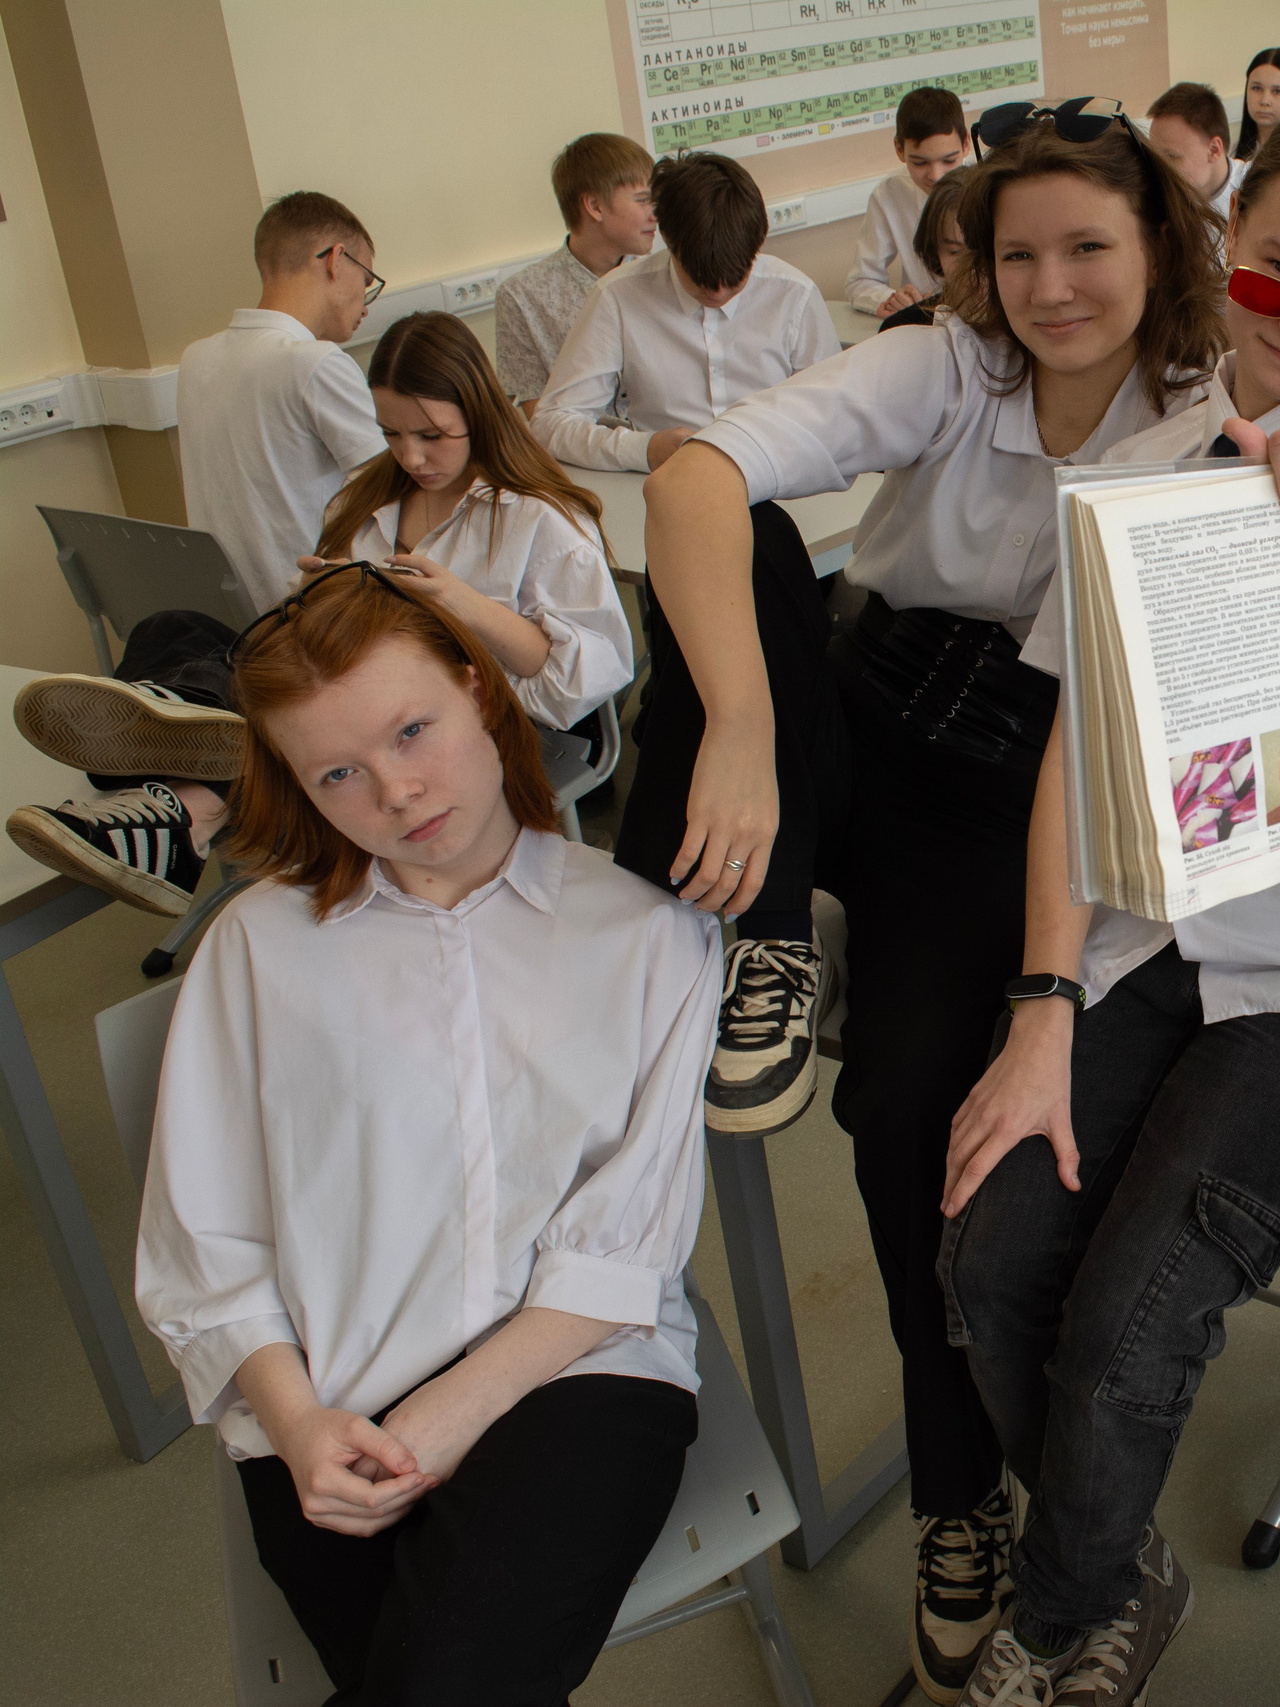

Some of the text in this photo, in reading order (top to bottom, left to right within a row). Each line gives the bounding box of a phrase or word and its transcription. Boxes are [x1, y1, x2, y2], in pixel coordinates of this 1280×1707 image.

[640, 0, 664, 9] ОКСИДЫ
[1062, 7, 1076, 18] как
[1077, 3, 1111, 16] начинают
[1060, 14, 1149, 35] Точная наука немыслима
[663, 68, 679, 81] Ce
[700, 63, 712, 76] Pr
[730, 58, 745, 71] Nd
[760, 54, 776, 66] Pm
[791, 49, 806, 62] Sm
[823, 45, 835, 57] Eu
[850, 40, 863, 53] Gd
[878, 37, 889, 49] Tb
[904, 34, 915, 47] Dy
[930, 30, 941, 41] Ho
[956, 26, 965, 38] Er
[976, 24, 988, 35] Tm
[1001, 20, 1011, 31] Yb
[1024, 17, 1034, 28] Lu
[1089, 35, 1101, 48] без
[643, 41, 747, 66] ЛАНТАНОИДЫ
[671, 124, 687, 137] Th
[706, 119, 720, 132] Pa
[743, 111, 751, 124] U
[768, 107, 782, 120] Np
[800, 101, 812, 114] Pu
[826, 97, 841, 109] Am
[853, 92, 868, 104] Cm
[884, 87, 895, 98] Bk
[935, 78, 945, 89] Es
[957, 74, 969, 85] Fm
[980, 70, 992, 81] Md
[1004, 66, 1015, 77] No
[1029, 62, 1037, 73] Lr
[651, 96, 744, 122] АКТИНОИДЫ
[841, 117, 870, 128] элементы
[781, 128, 813, 140] элементы
